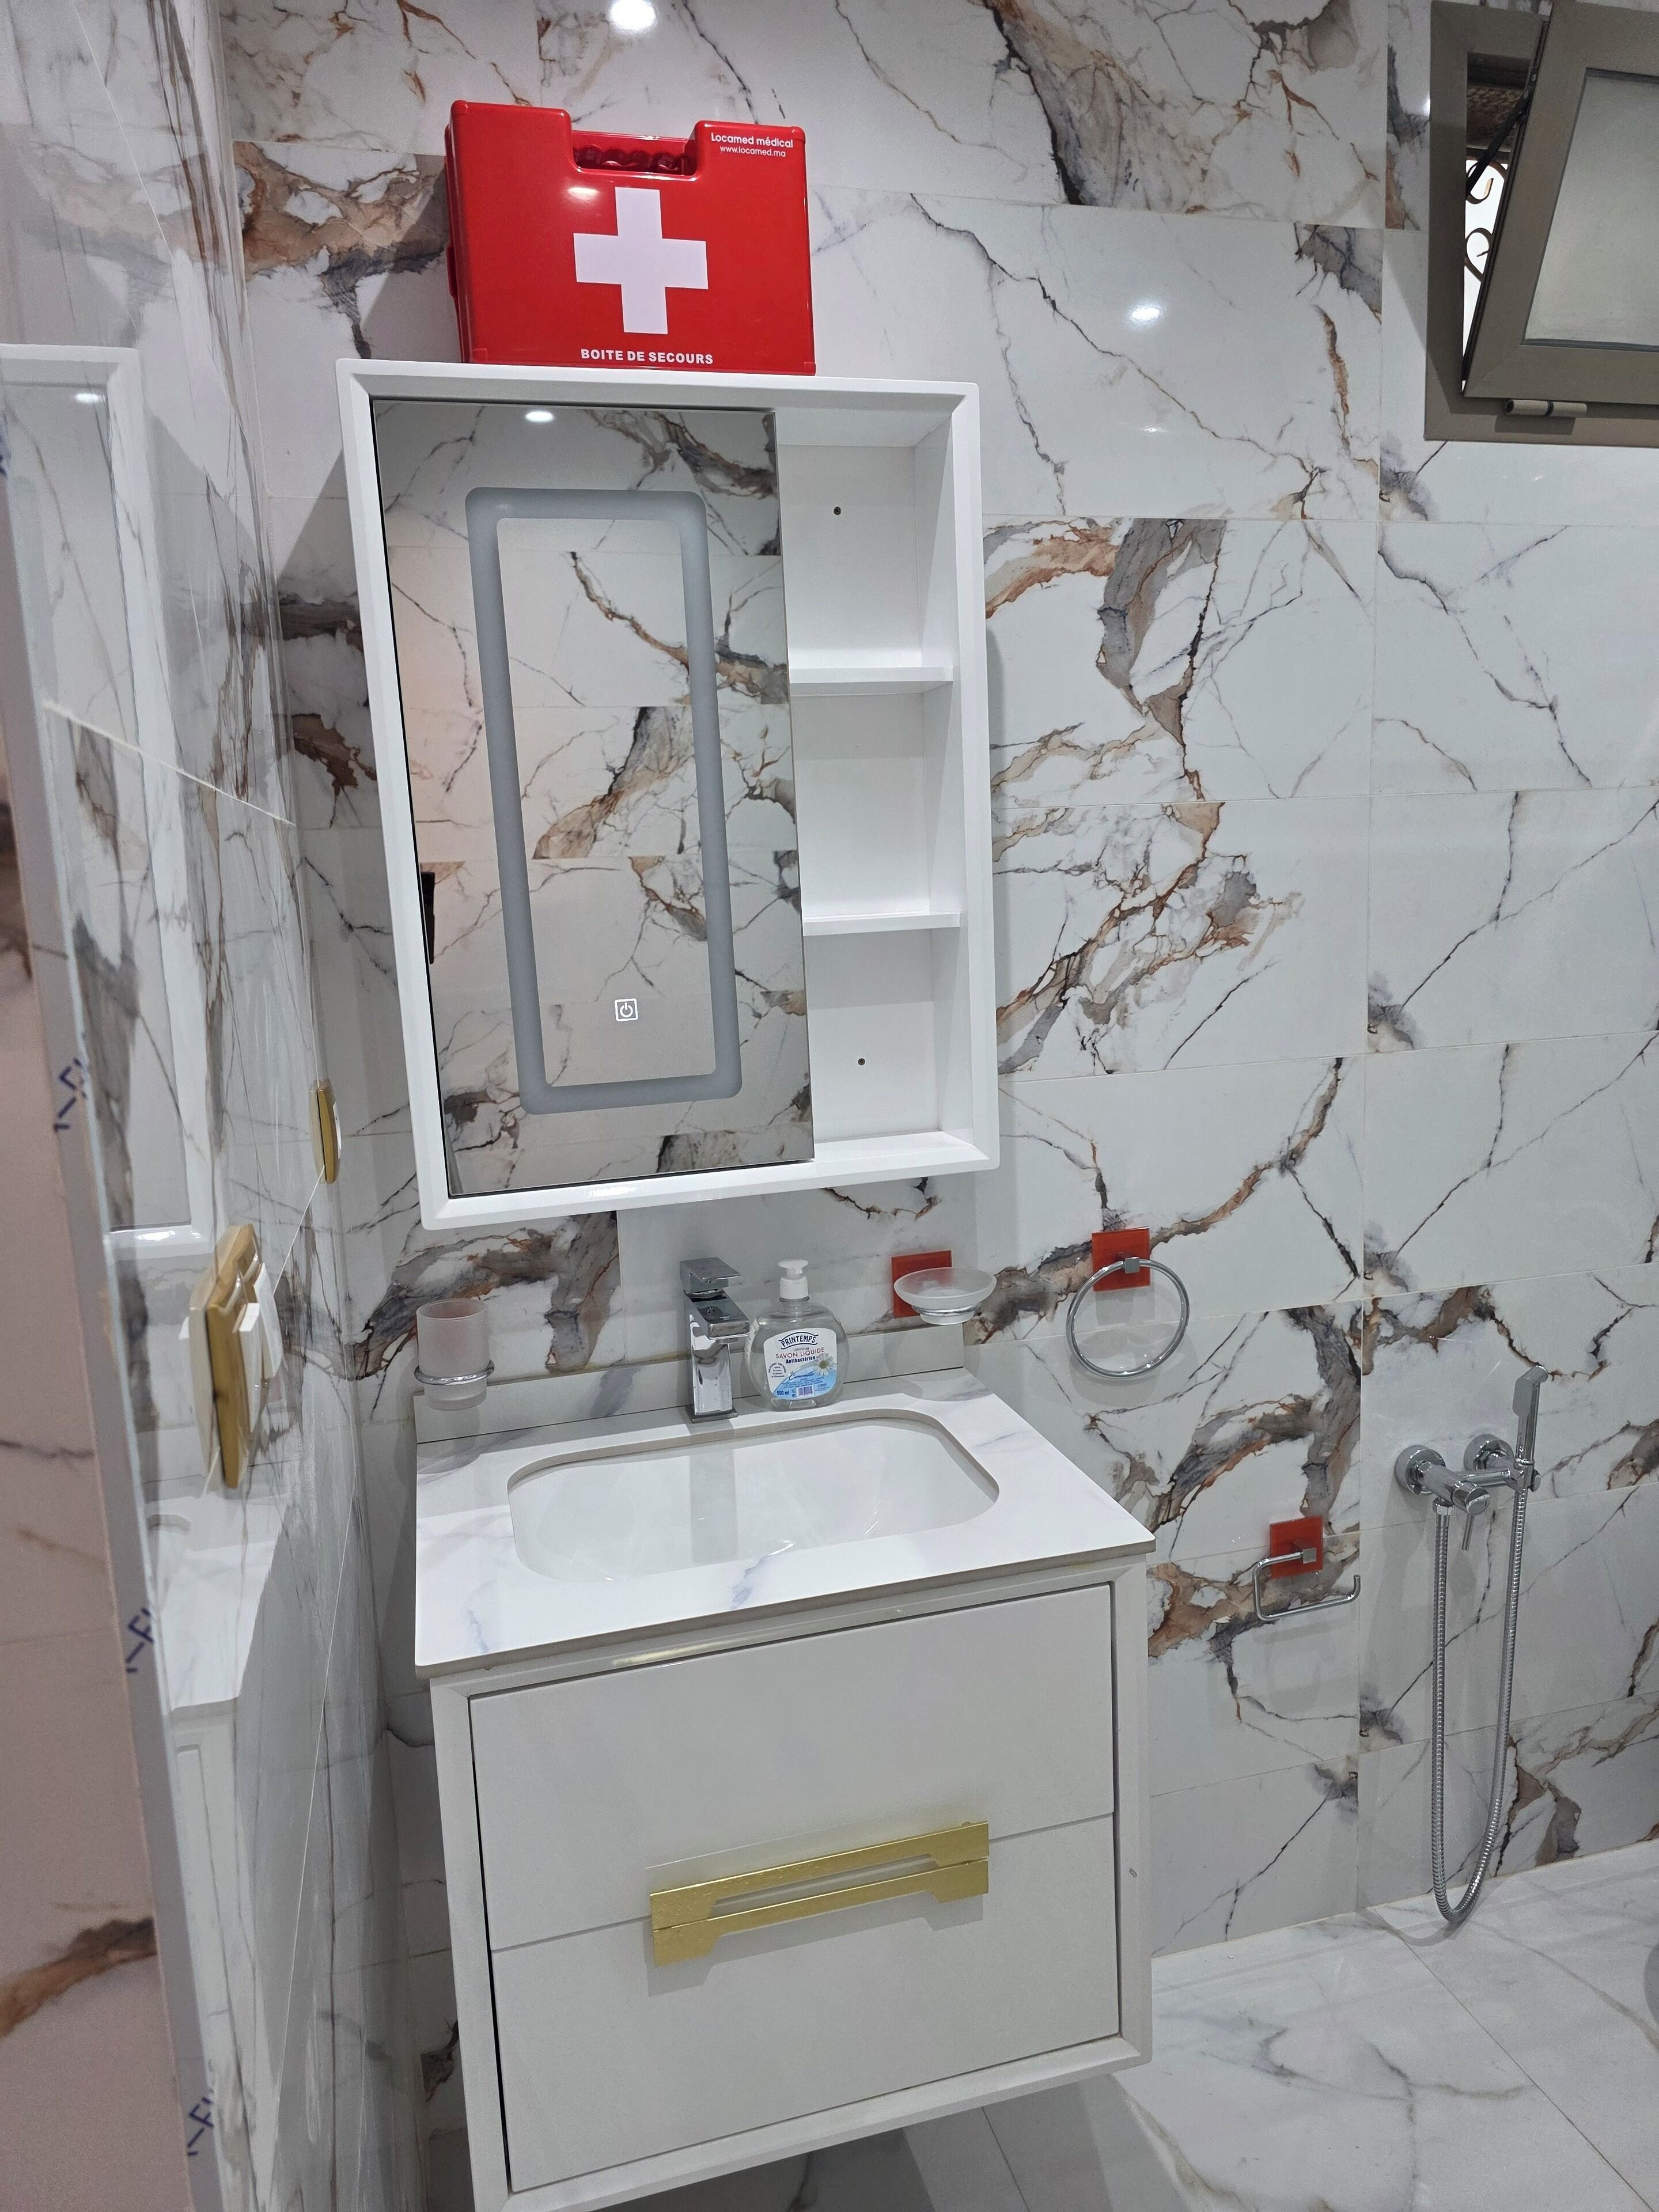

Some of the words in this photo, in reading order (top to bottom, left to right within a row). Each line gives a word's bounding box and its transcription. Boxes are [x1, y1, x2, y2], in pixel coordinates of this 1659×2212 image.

[711, 132, 754, 145] Locamed
[756, 137, 793, 148] médical
[720, 146, 786, 157] www.locamed.ma
[581, 349, 624, 360] BOITE
[627, 351, 645, 362] DE
[649, 352, 713, 364] SECOURS
[781, 1335, 816, 1347] PRINTEMPS
[800, 1347, 824, 1357] LIQUIDE
